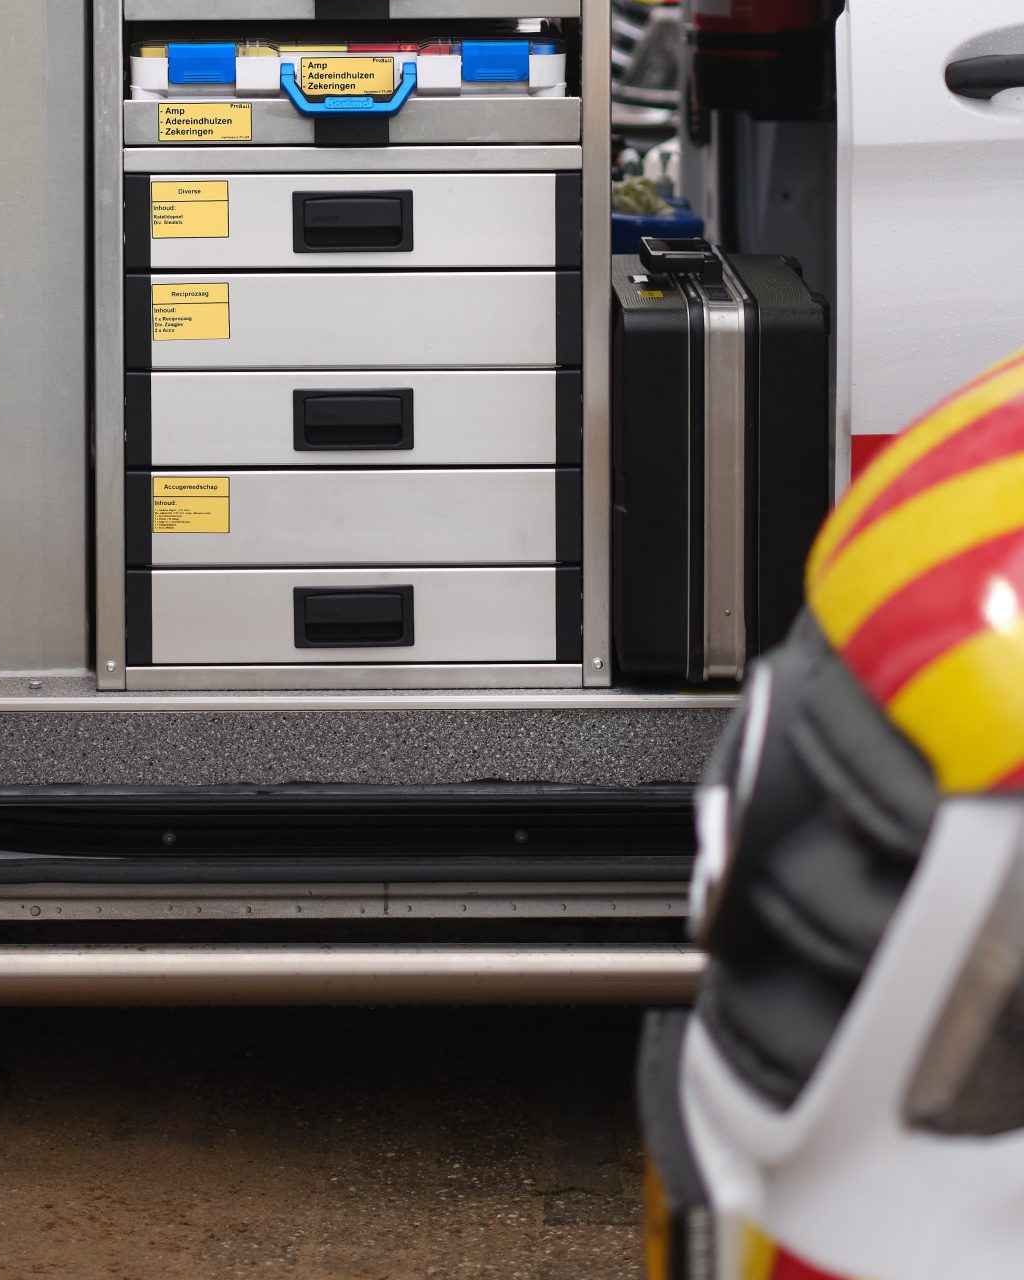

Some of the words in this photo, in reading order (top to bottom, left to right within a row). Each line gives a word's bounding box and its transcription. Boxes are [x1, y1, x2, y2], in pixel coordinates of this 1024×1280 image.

[307, 62, 327, 70] Amp
[307, 72, 375, 80] Adereindhulzen
[307, 82, 356, 91] Zekeringen
[165, 107, 185, 116] Amp
[165, 117, 232, 125] Adereindhulzen
[165, 128, 214, 136] Zekeringen
